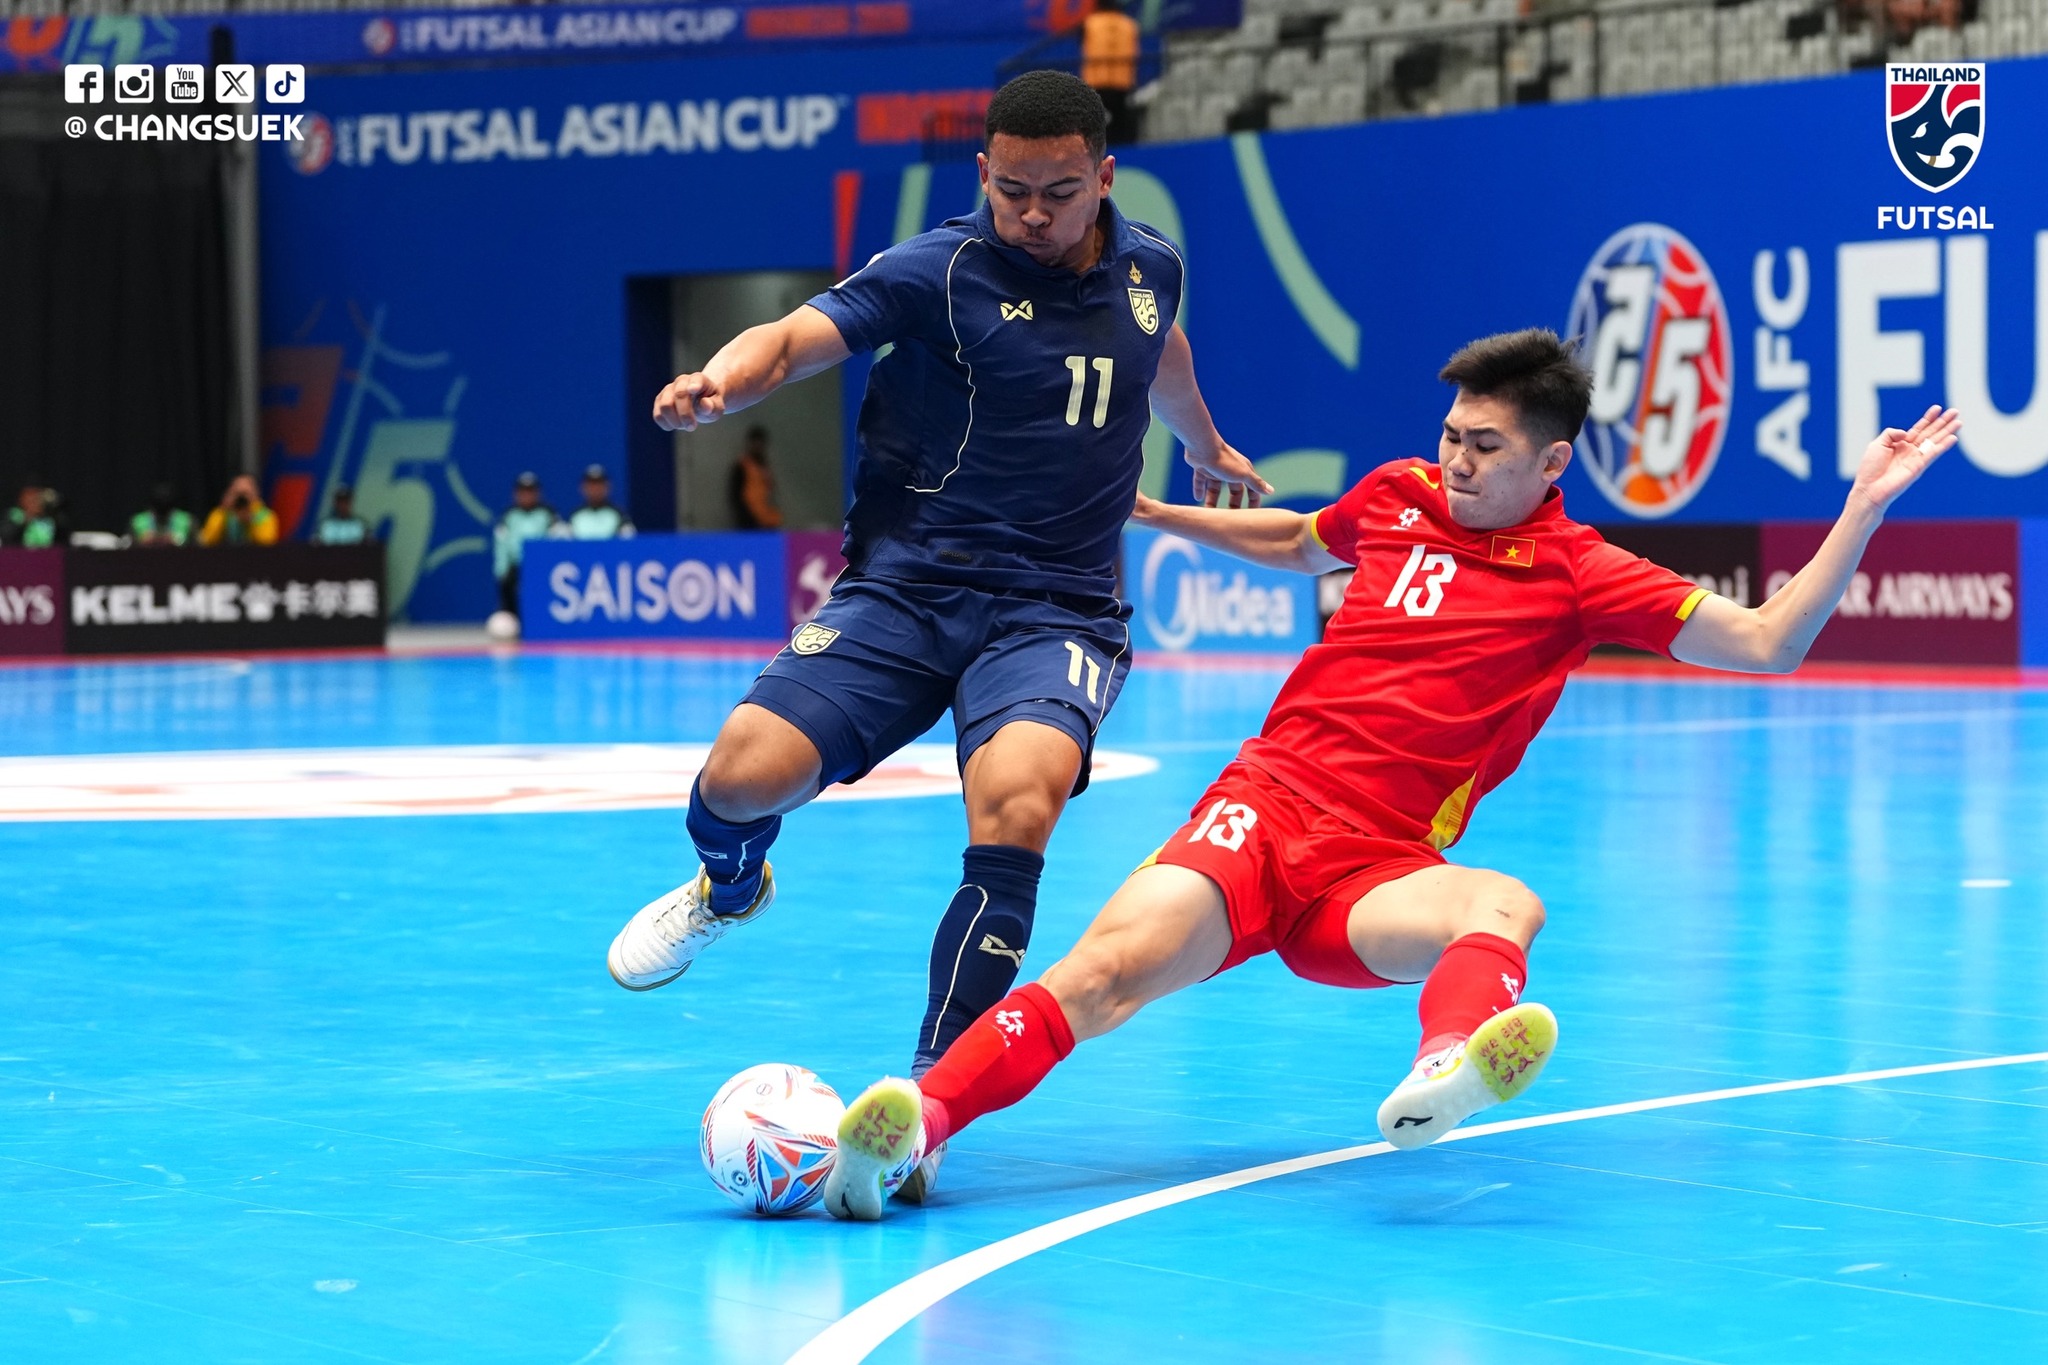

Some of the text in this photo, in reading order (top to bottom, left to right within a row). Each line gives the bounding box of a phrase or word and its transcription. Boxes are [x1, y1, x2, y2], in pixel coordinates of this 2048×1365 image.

[415, 15, 549, 49] FUTSAL
[359, 110, 550, 166] FUTSAL
[556, 99, 722, 158] ASIAN
[724, 95, 842, 150] CUP
[1064, 355, 1114, 429] 11
[1751, 245, 1812, 482] AFC
[71, 582, 242, 626] KELME
[549, 559, 756, 624] SAISON
[1383, 544, 1458, 617] 13
[1877, 571, 2014, 622] AIRWAYS
[1064, 640, 1101, 705] 11
[1186, 797, 1259, 854] 13
